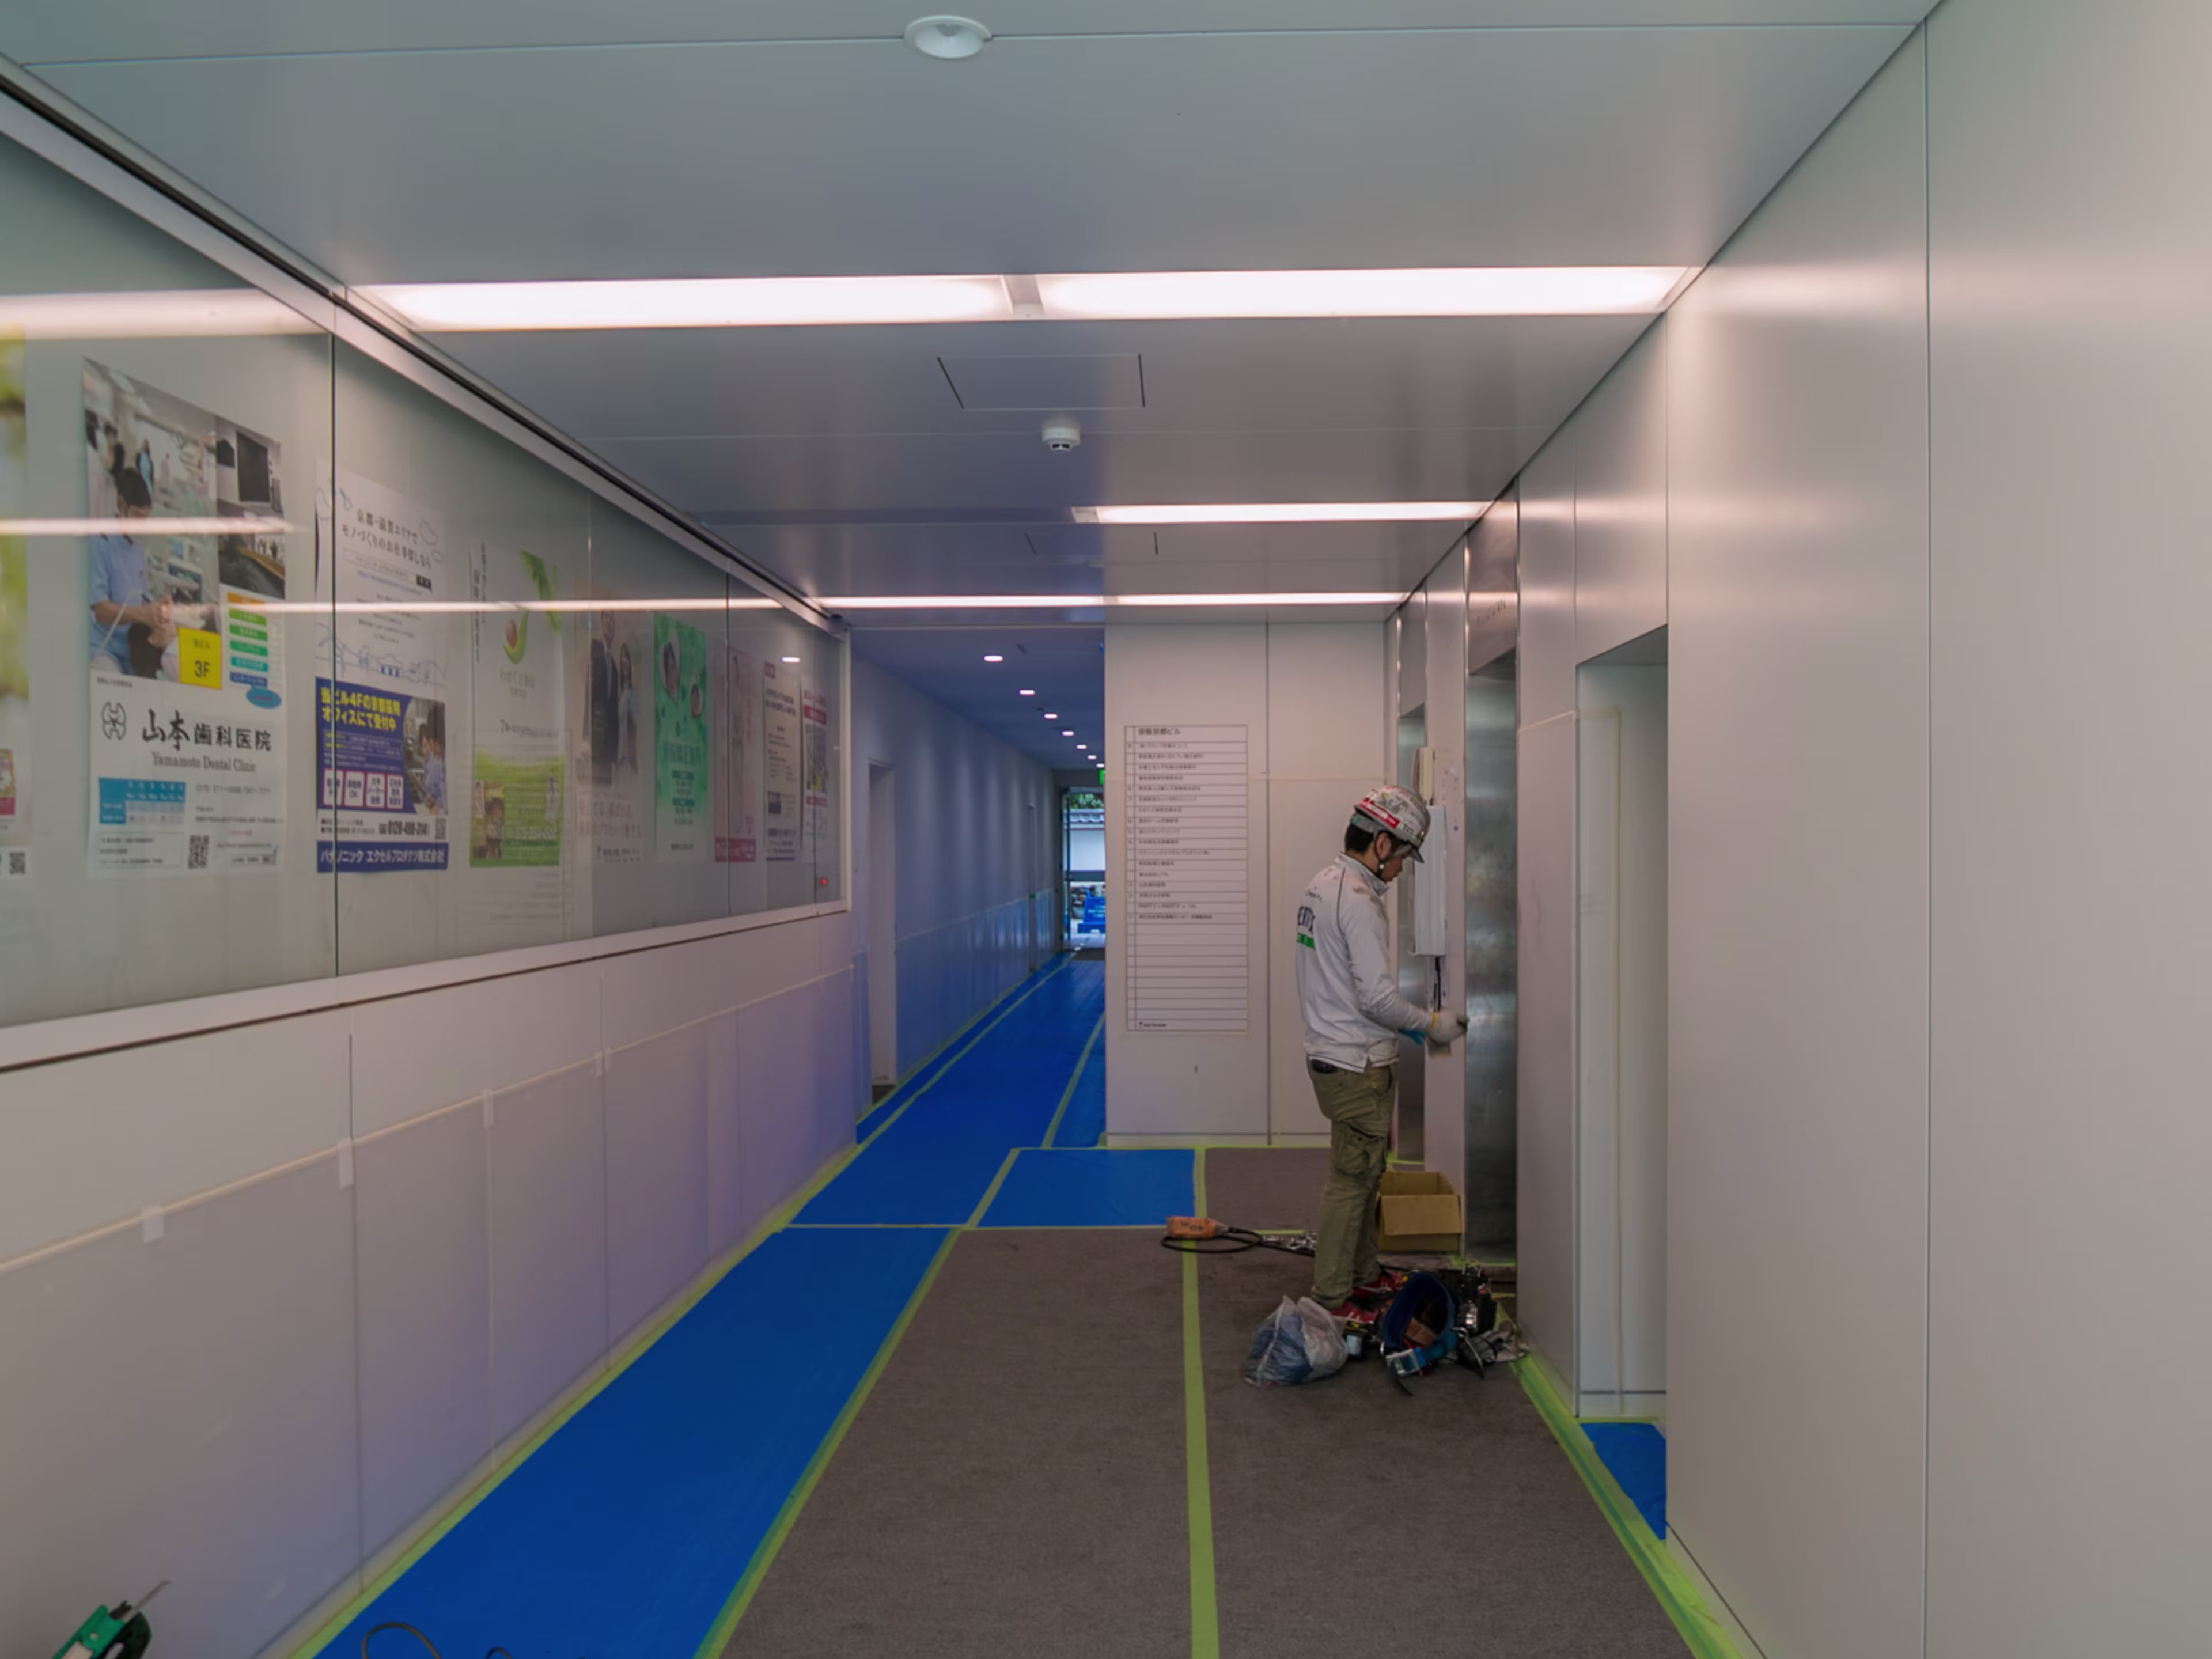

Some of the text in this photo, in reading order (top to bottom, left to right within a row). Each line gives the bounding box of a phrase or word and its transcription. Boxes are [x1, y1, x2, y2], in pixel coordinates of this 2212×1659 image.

[194, 660, 211, 679] 3F
[142, 707, 272, 752] 山本歯科医院
[151, 752, 257, 772] Yamamoto Dental Clinic
